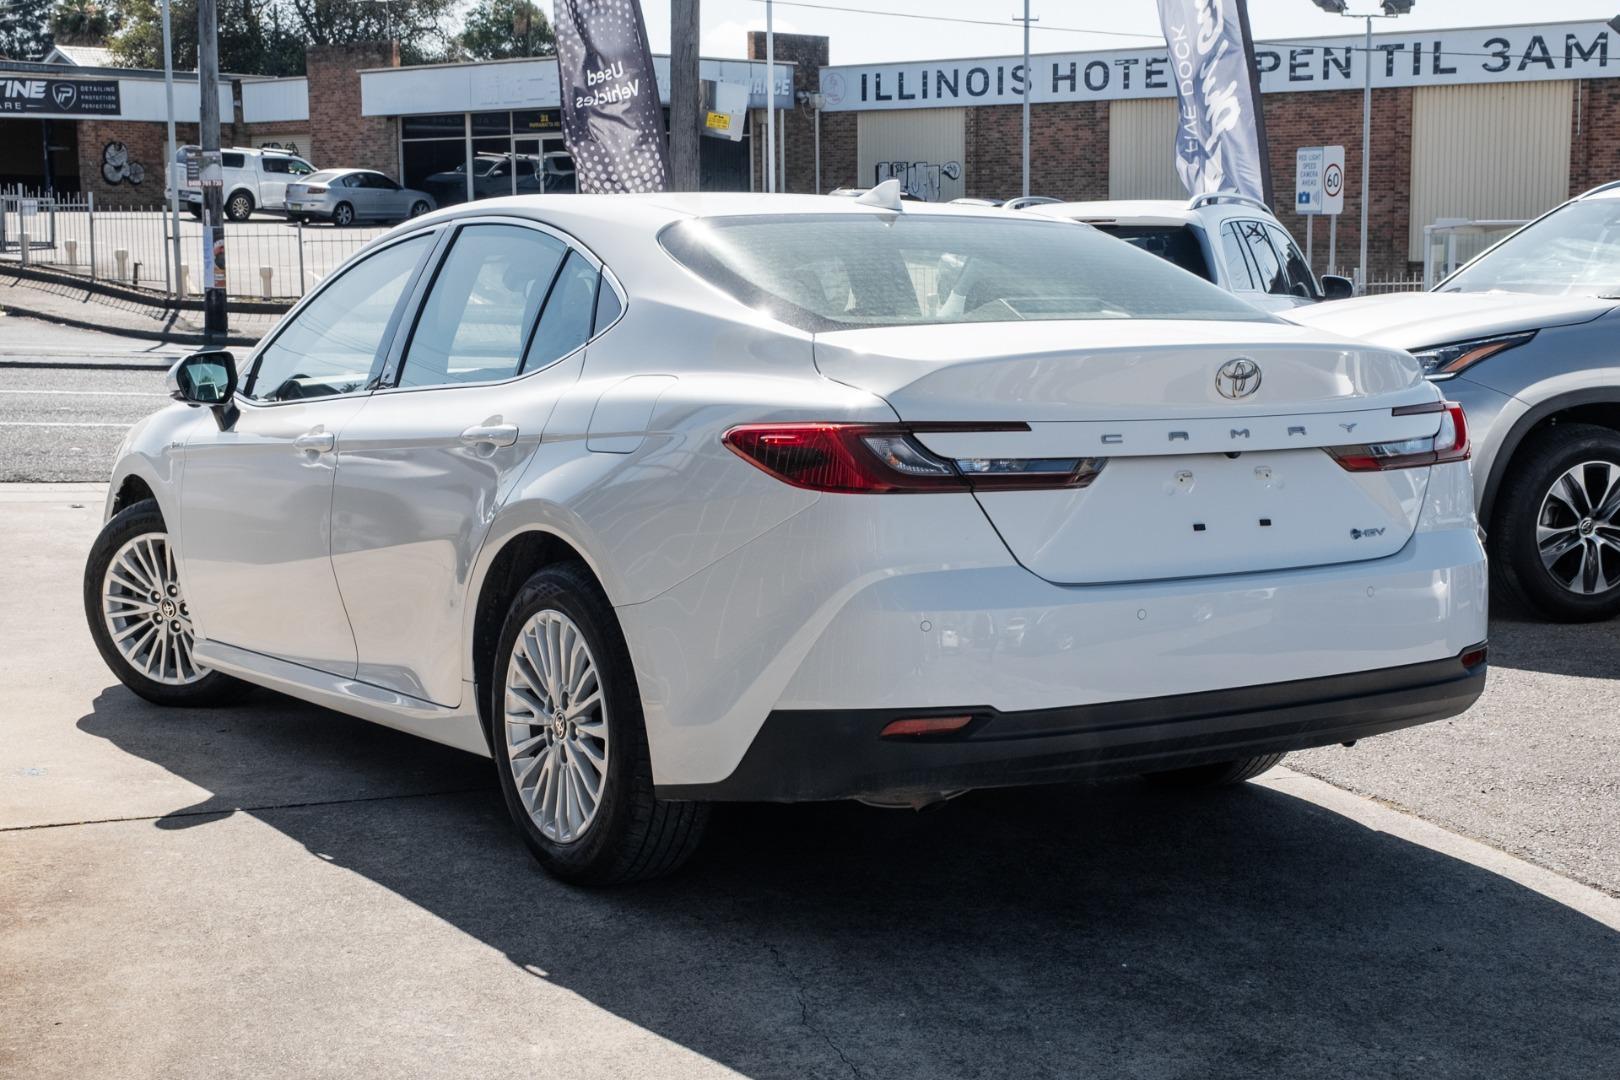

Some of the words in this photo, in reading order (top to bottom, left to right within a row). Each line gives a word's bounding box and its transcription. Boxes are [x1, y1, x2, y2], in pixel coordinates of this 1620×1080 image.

[860, 64, 1032, 102] ILLINOIS
[1051, 57, 1168, 94] HOTE
[1255, 47, 1352, 83] PEN
[1376, 41, 1458, 78] TIL
[1482, 32, 1610, 73] 3AM
[1327, 172, 1339, 188] 60
[1101, 423, 1358, 445] CAMRY
